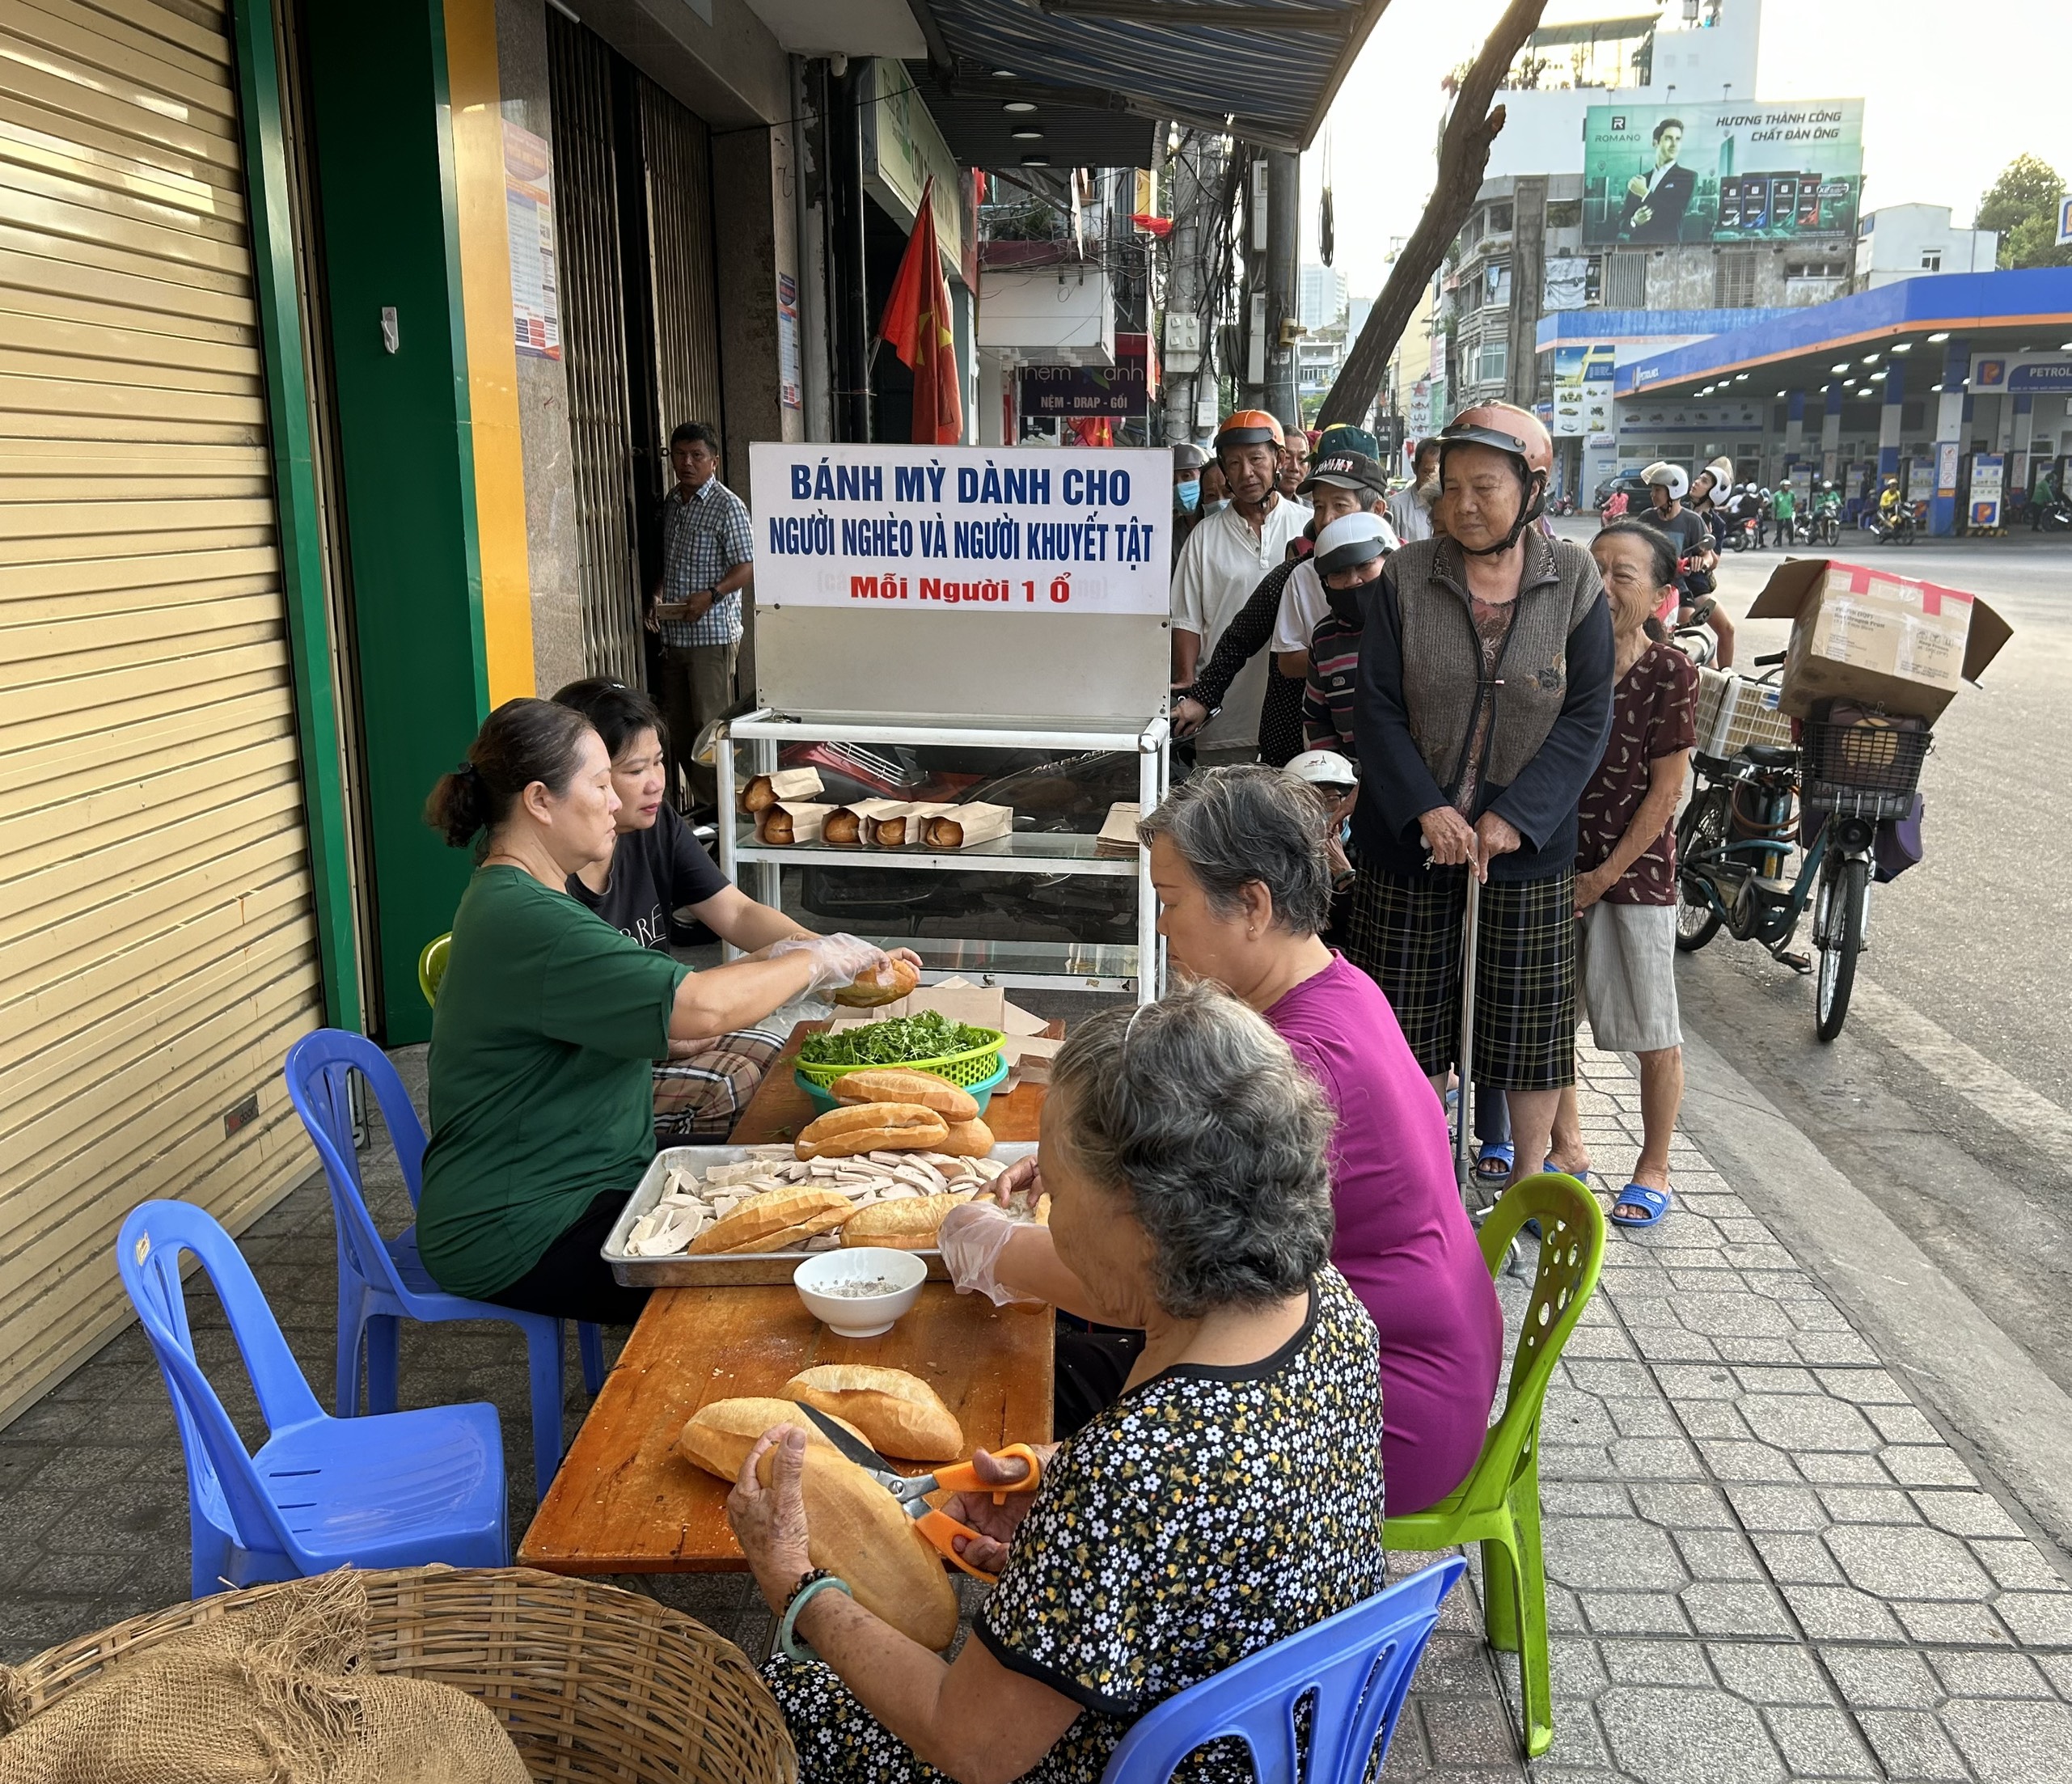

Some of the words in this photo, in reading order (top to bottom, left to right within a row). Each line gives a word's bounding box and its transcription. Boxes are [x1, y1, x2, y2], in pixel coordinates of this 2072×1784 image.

[1716, 115, 1762, 127] HƯƠNG
[1765, 112, 1806, 125] THÀNH
[1808, 109, 1842, 122] CÔNG
[1595, 133, 1641, 142] ROMANO
[1751, 127, 1782, 142] CHẤT
[1785, 128, 1811, 140] ĐÀN
[1813, 126, 1840, 139] ÔNG
[1040, 395, 1064, 411] NỆM
[1074, 396, 1101, 408] DRAP
[1110, 393, 1128, 409] GỐI
[790, 456, 883, 501] BÁNH
[894, 458, 949, 504] MỲ
[958, 459, 1051, 506] DÀNH
[1062, 467, 1131, 507] CHO
[769, 509, 835, 556] NGƯỜI
[841, 510, 913, 558] NGHÈO
[919, 511, 949, 560] VÀ
[954, 511, 1021, 561] NGƯỜI
[1026, 509, 1110, 563] KHUYẾT
[1114, 516, 1155, 571] TẬT
[850, 573, 908, 600] Mỗi
[919, 577, 1010, 603] Người
[1021, 580, 1035, 602] 1
[1049, 571, 1072, 604] Ổ
